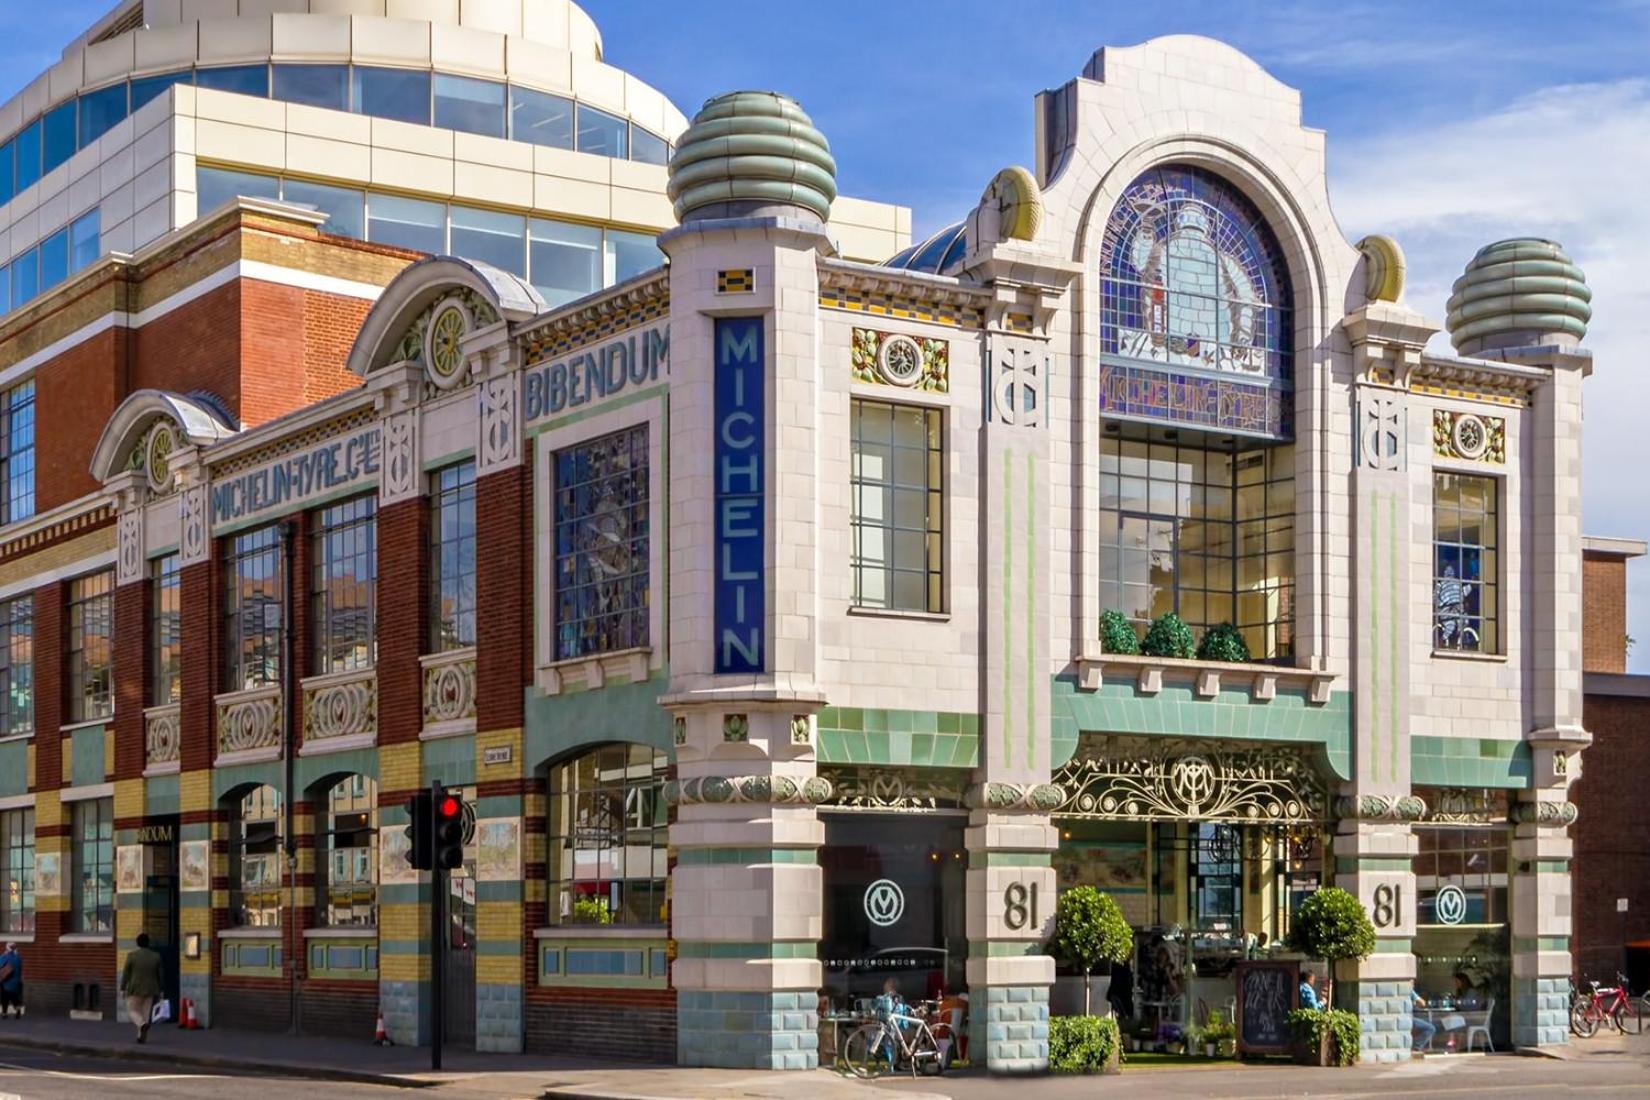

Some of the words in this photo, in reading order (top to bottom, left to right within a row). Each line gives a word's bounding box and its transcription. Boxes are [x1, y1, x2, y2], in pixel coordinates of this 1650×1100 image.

[526, 323, 671, 421] BIBENDUM
[721, 326, 760, 667] MICHELIN
[1004, 881, 1038, 931] 81
[1373, 883, 1401, 929] 81
